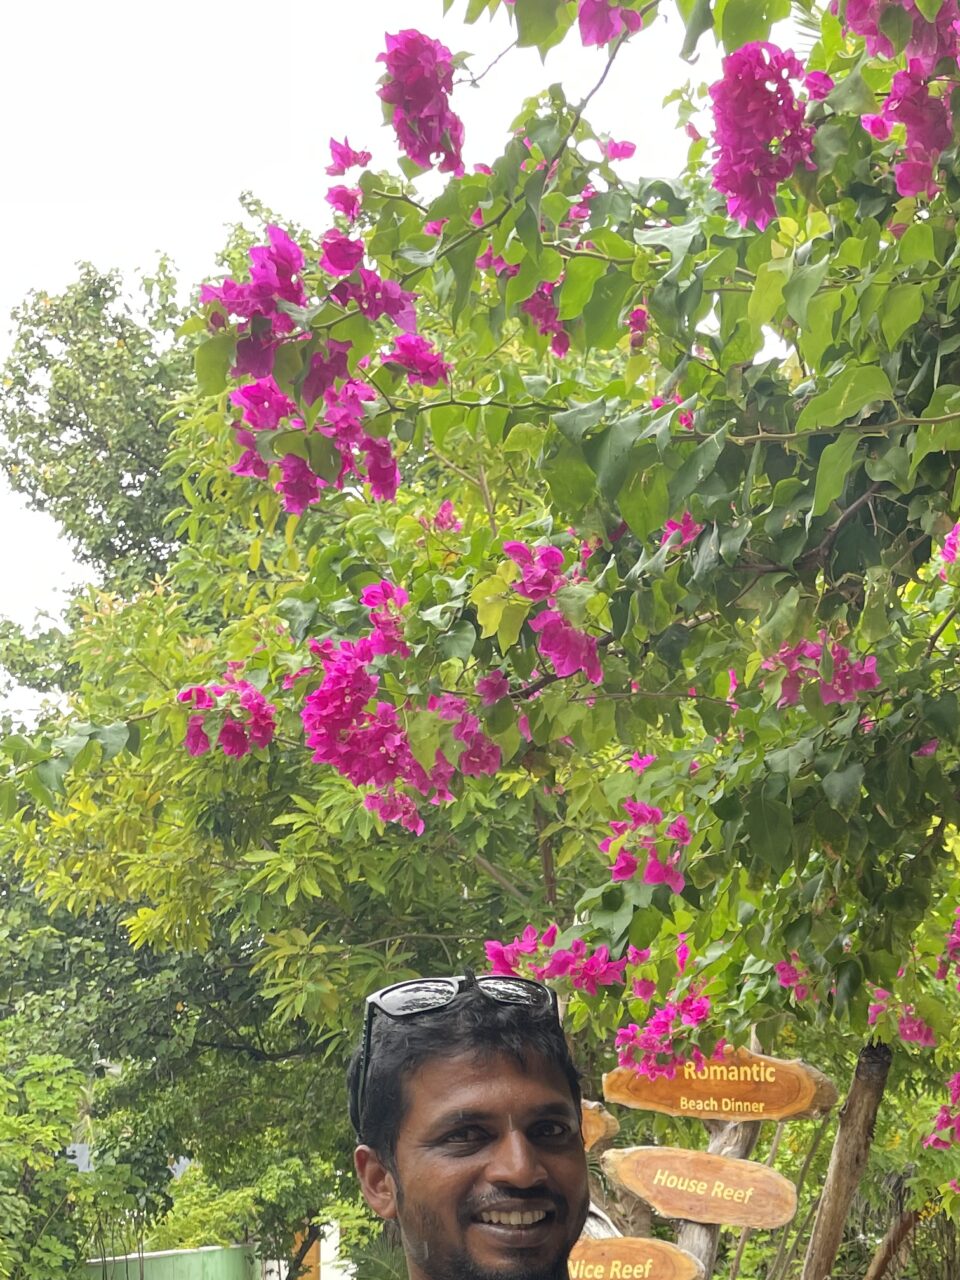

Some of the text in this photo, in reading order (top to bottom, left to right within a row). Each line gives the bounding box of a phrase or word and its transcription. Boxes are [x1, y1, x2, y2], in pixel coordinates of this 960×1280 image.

[684, 1061, 776, 1083] Romantic
[680, 1096, 765, 1113] Beach Dinner
[653, 1169, 755, 1204] House Reef
[567, 1258, 653, 1279] Nice Reef
